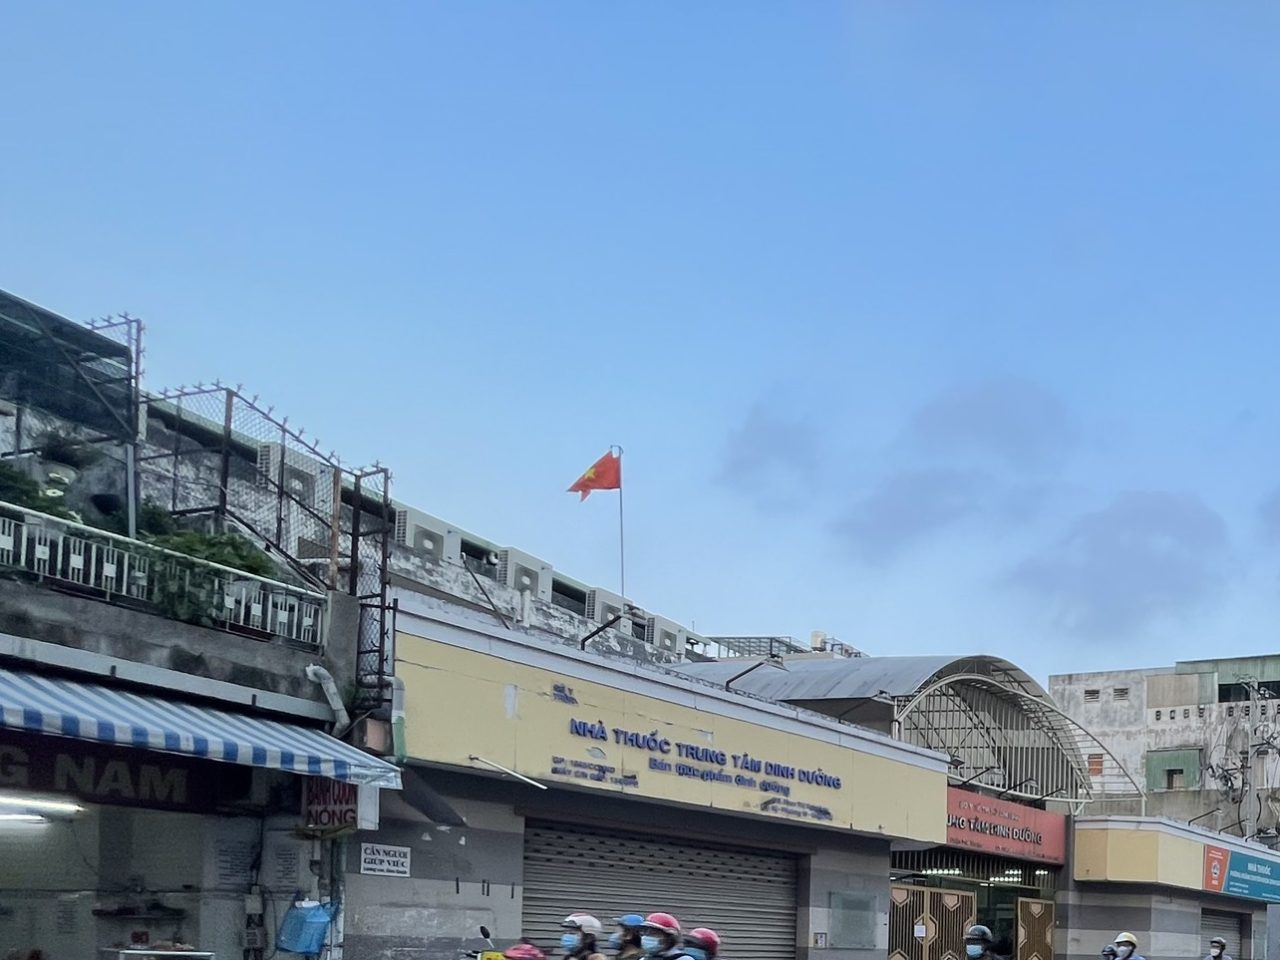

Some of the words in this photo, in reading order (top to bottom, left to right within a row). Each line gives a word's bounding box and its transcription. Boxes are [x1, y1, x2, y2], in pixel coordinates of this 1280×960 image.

[570, 717, 608, 741] NHÀ
[612, 729, 671, 754] THUỐC
[675, 742, 727, 766] TRUNG
[731, 752, 761, 773] TÂM
[764, 761, 795, 780] DINH
[798, 767, 842, 790] DƯỠNG
[54, 752, 189, 804] NAM
[307, 806, 356, 826] NÓNG
[968, 815, 989, 834] TÂM
[1013, 826, 1043, 846] DƯỠNG
